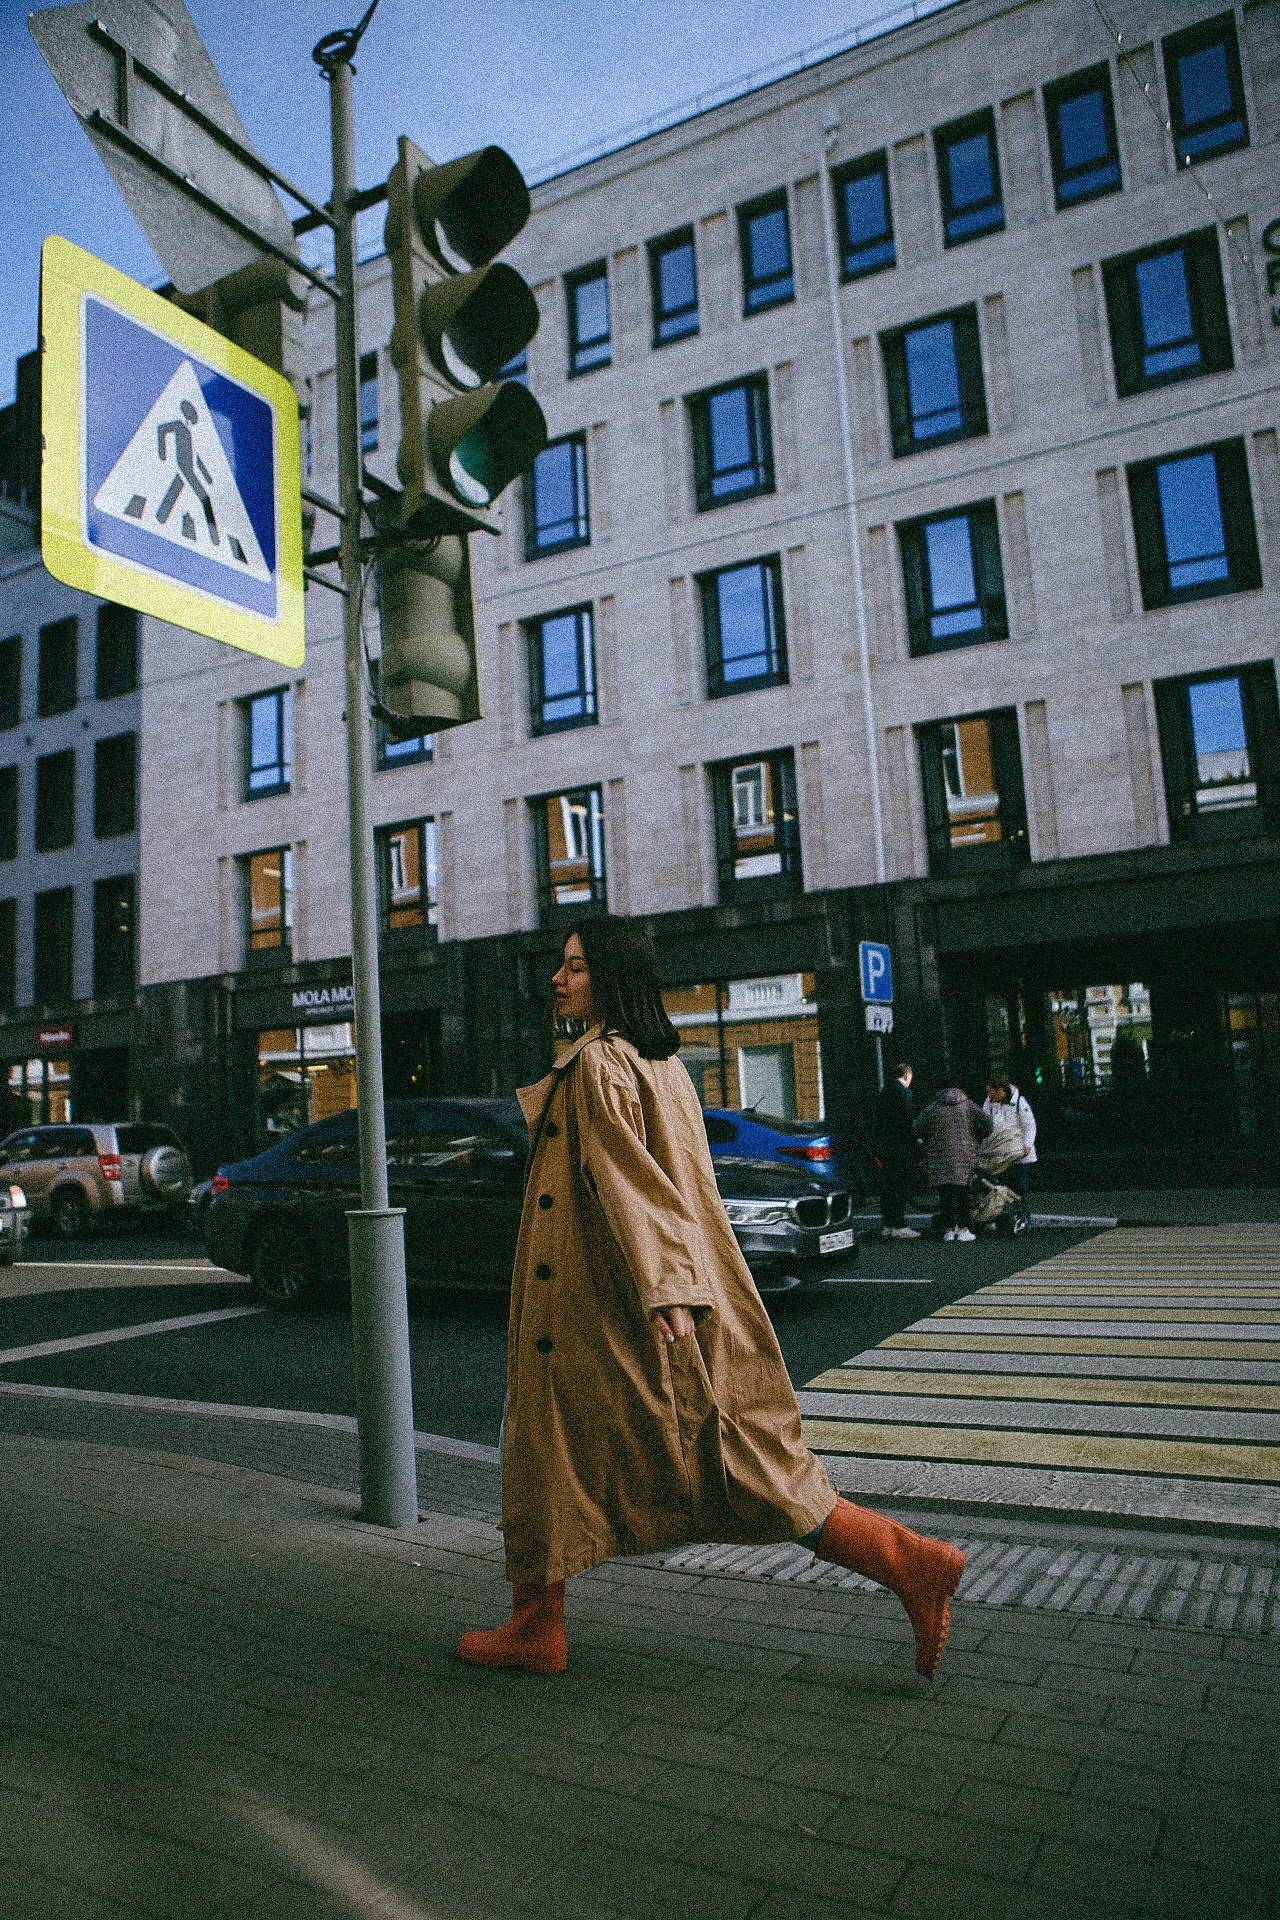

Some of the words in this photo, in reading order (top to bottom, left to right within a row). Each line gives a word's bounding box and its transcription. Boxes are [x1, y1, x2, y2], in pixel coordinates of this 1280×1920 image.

[868, 950, 885, 994] P
[292, 989, 330, 1007] MOLA
[331, 986, 354, 1002] MO
